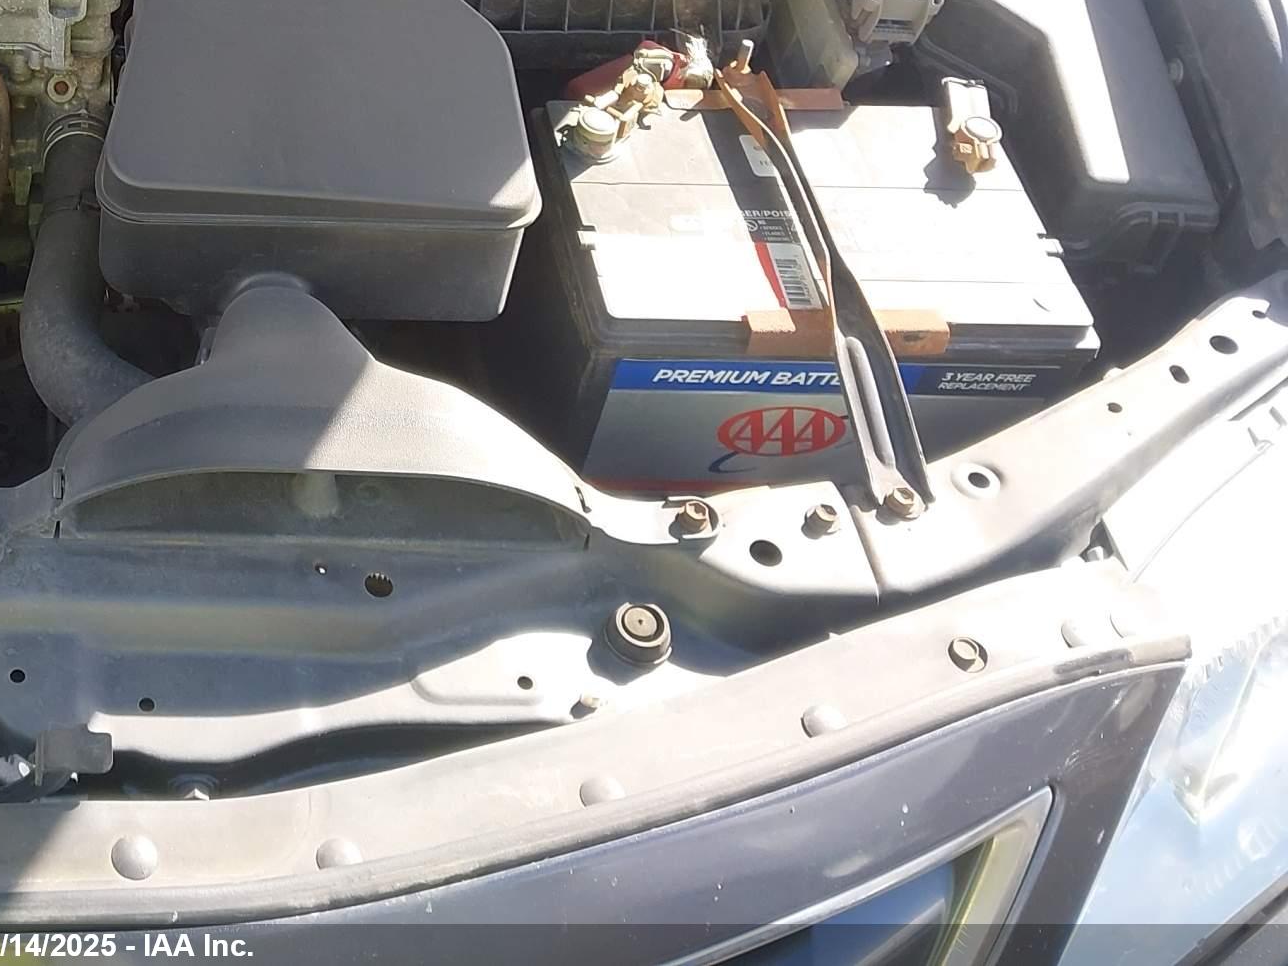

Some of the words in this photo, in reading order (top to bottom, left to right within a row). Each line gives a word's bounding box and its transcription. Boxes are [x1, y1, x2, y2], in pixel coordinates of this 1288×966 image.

[652, 369, 772, 385] PREMIUM
[941, 372, 954, 382] 3
[954, 373, 995, 382] YEAR
[994, 374, 1037, 383] FREE
[937, 382, 1030, 391] REPLACEMENT
[718, 406, 846, 456] AAA
